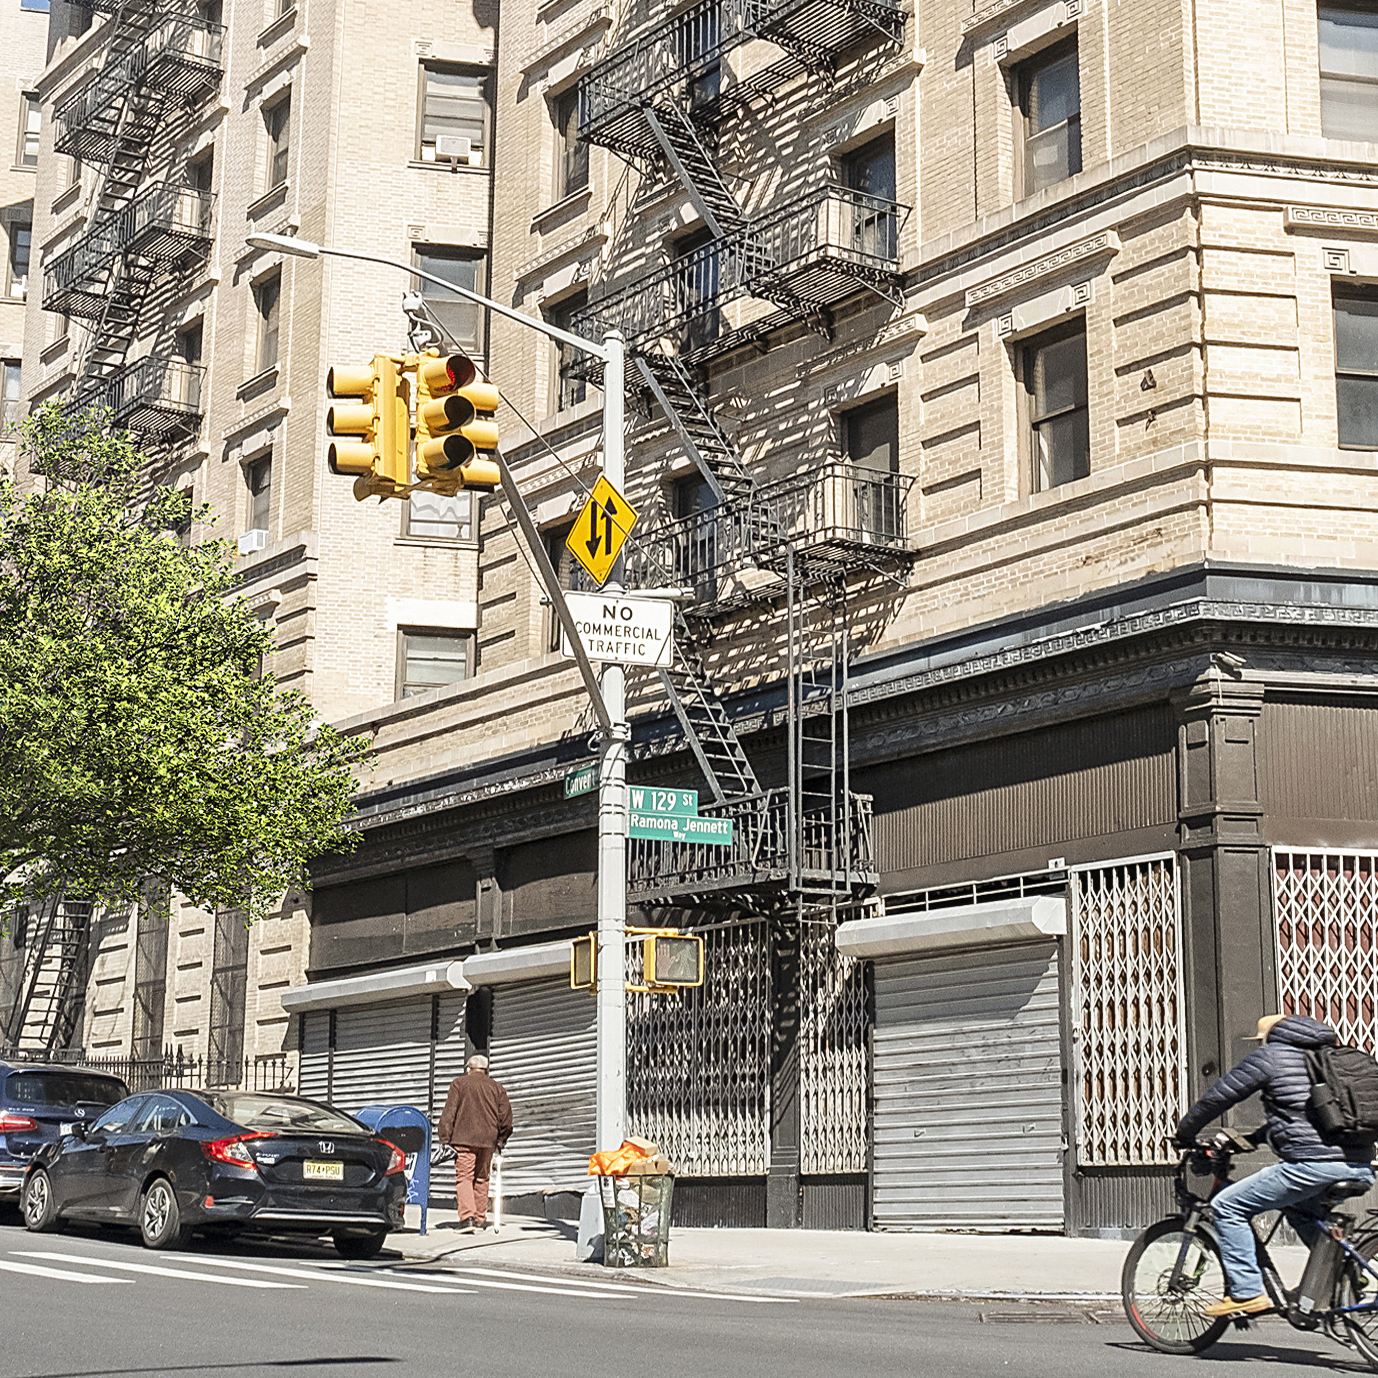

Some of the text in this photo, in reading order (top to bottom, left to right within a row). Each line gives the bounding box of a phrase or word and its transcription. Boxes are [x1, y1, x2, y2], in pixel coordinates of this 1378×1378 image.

[603, 604, 633, 621] NO
[575, 621, 661, 641] COMMERCIAL
[588, 639, 646, 656] TRAFFIC
[631, 789, 693, 811] W 129 St
[630, 813, 728, 835] Ramona Jennett
[672, 830, 686, 841] Way
